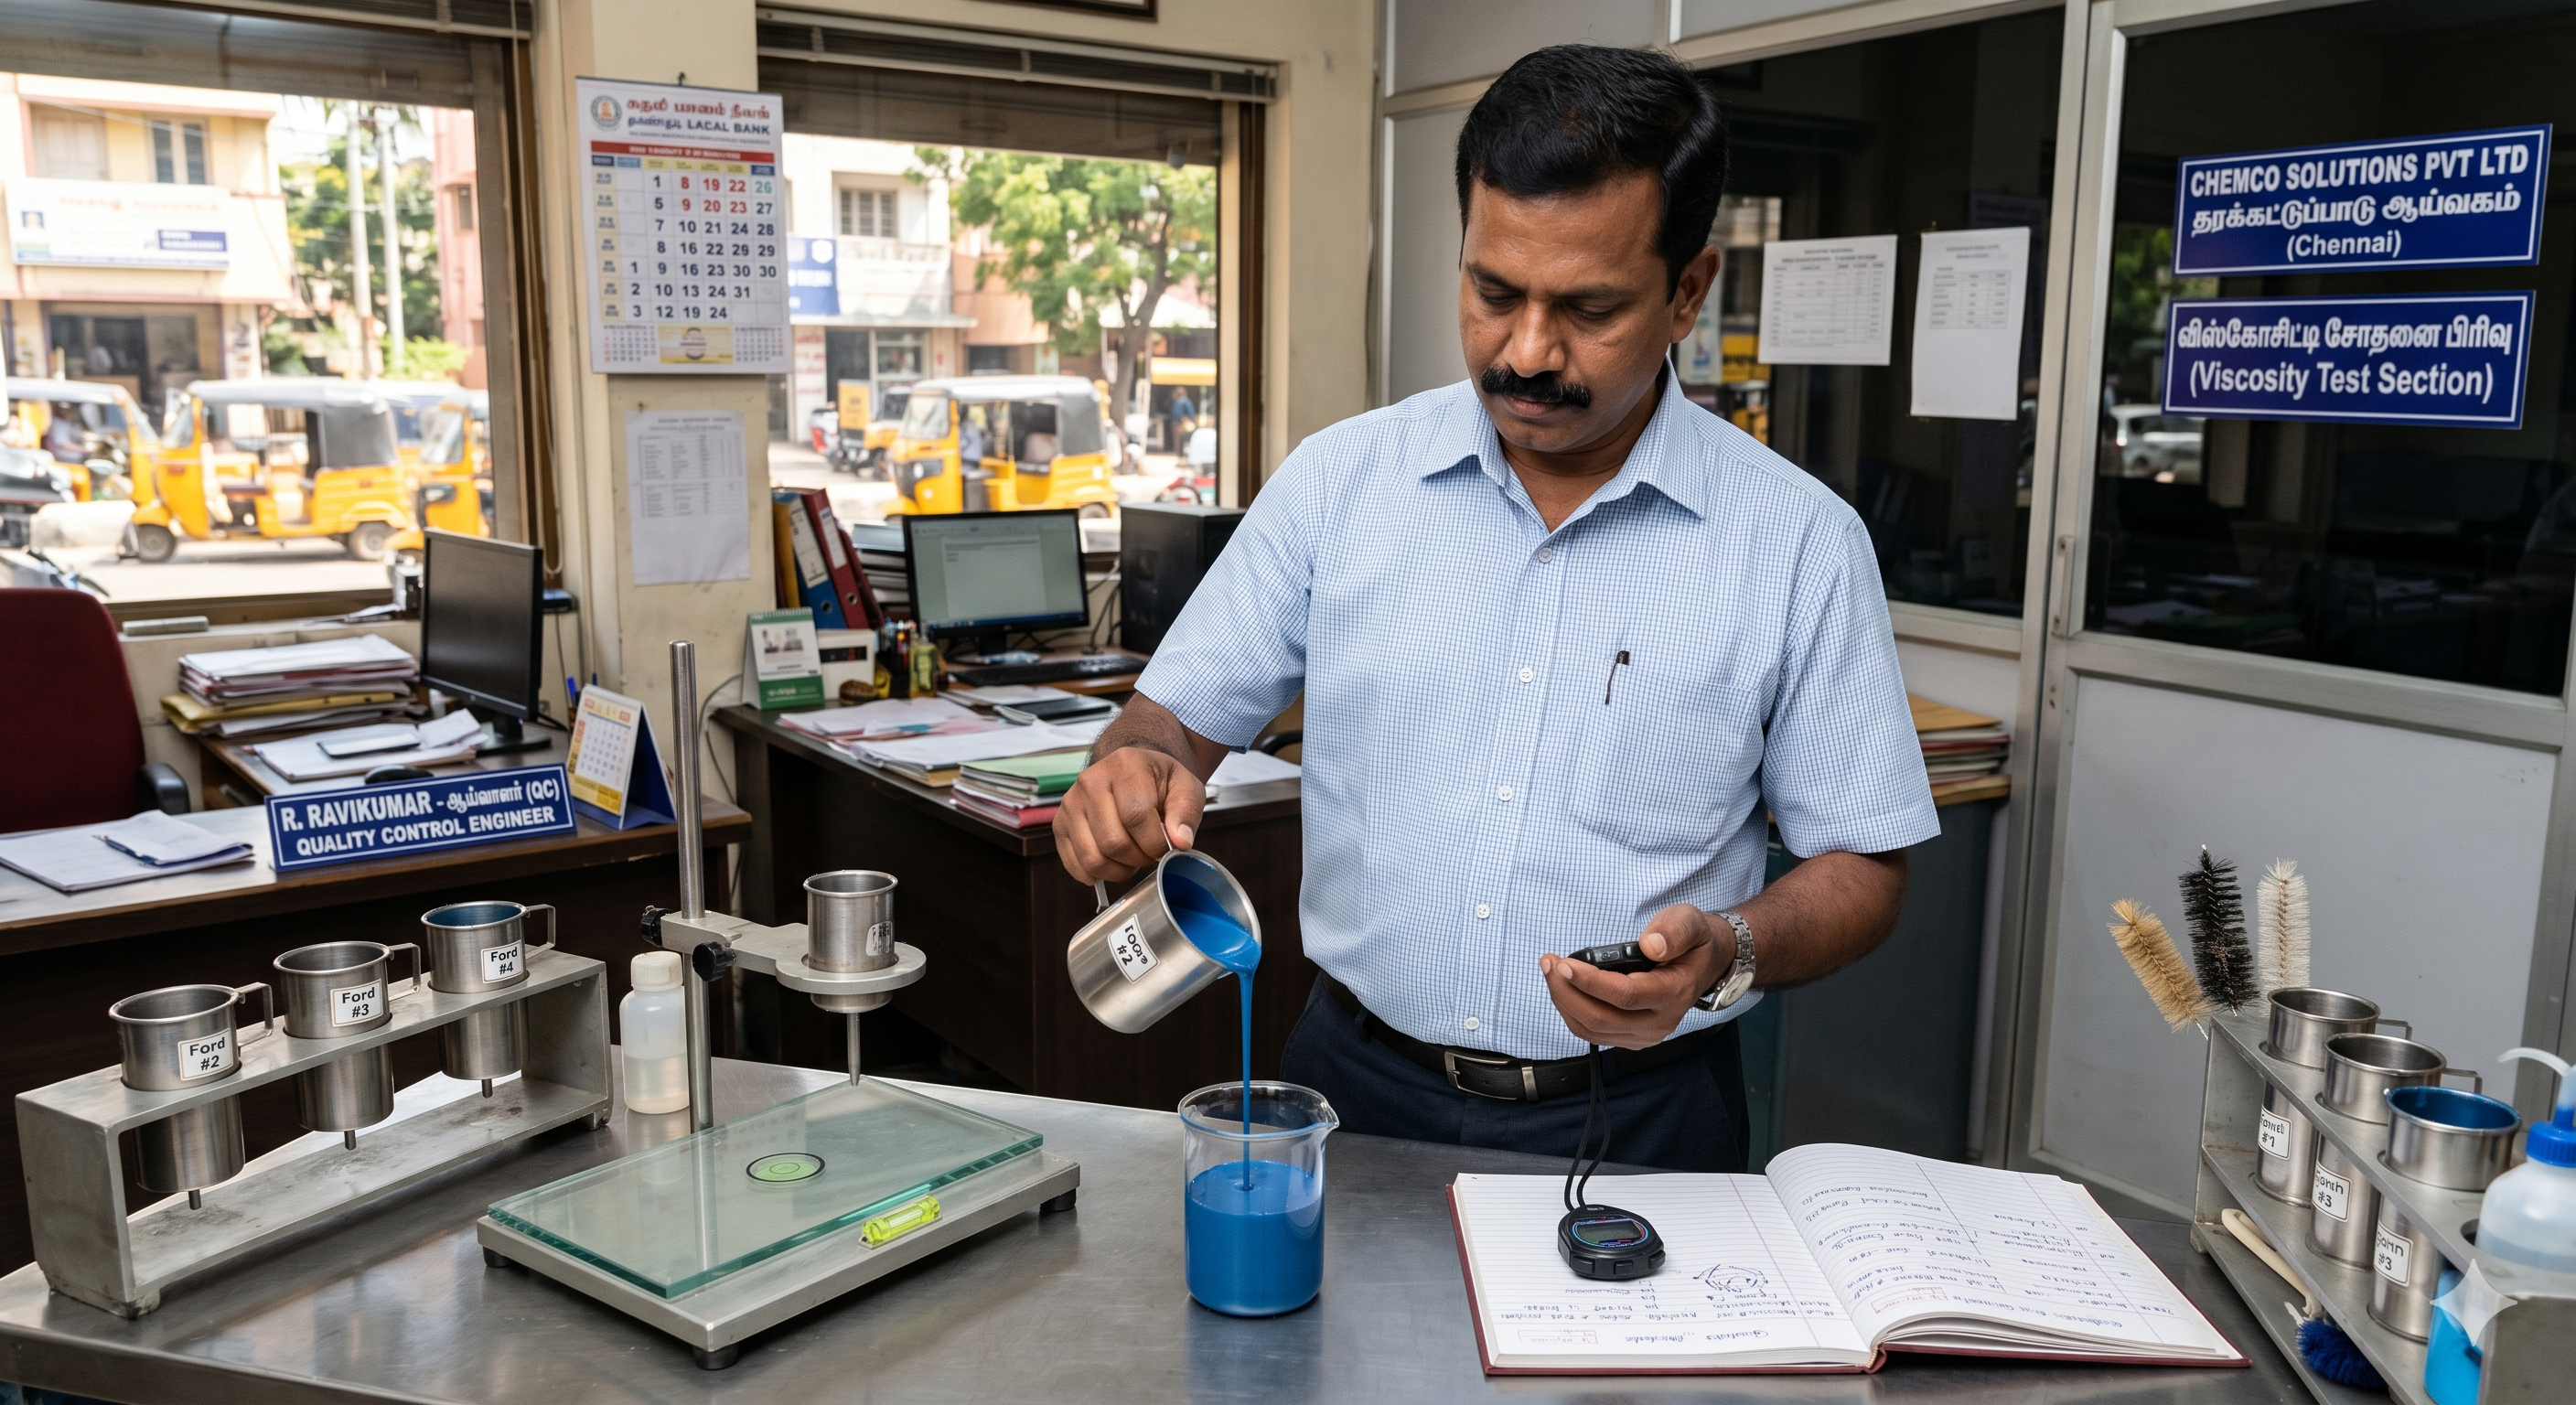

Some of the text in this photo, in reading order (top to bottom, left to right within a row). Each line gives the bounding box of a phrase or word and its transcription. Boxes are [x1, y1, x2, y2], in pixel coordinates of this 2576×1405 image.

[687, 120, 729, 133] LACAL
[734, 123, 770, 135] BANK
[2190, 144, 2529, 198] CHEMCO SOLUTIONS PVT LTD
[653, 175, 773, 195] 1 8 19 22 26
[654, 197, 773, 215] 5 9 20 23 27
[2191, 182, 2521, 238] தரக்கட்டுப்பாடு ஆய்வகம்
[655, 218, 775, 237] 7 10 21 24 28
[657, 241, 667, 254] 8
[680, 241, 698, 255] 16
[705, 242, 724, 256] 22
[757, 243, 776, 257] 29
[2286, 230, 2402, 263] (Chennai)
[630, 261, 639, 273] 1
[657, 262, 668, 275] 9
[681, 263, 699, 276] 16
[707, 263, 725, 277] 23
[733, 264, 751, 278] 30
[758, 264, 778, 278] 30
[631, 282, 750, 299] 2 10 13 24 31
[632, 305, 728, 319] 3 12 19 24
[2177, 314, 2514, 357] விஸ்கோசிட்டி சோதனை பிரிவு
[2189, 360, 2494, 404] (Viscosity Test Section)
[280, 806, 304, 831] R.
[306, 790, 434, 829] RAVIKUMAR
[525, 778, 560, 805] (QC)
[295, 805, 556, 856] QUALITY CONTROL ENGINEER
[489, 946, 519, 963] Ford
[1116, 944, 1133, 966] #2
[499, 960, 515, 975] #4
[340, 986, 376, 1004] Ford
[351, 1002, 370, 1018] #3
[188, 1036, 226, 1057] Ford
[199, 1055, 220, 1070] #2
